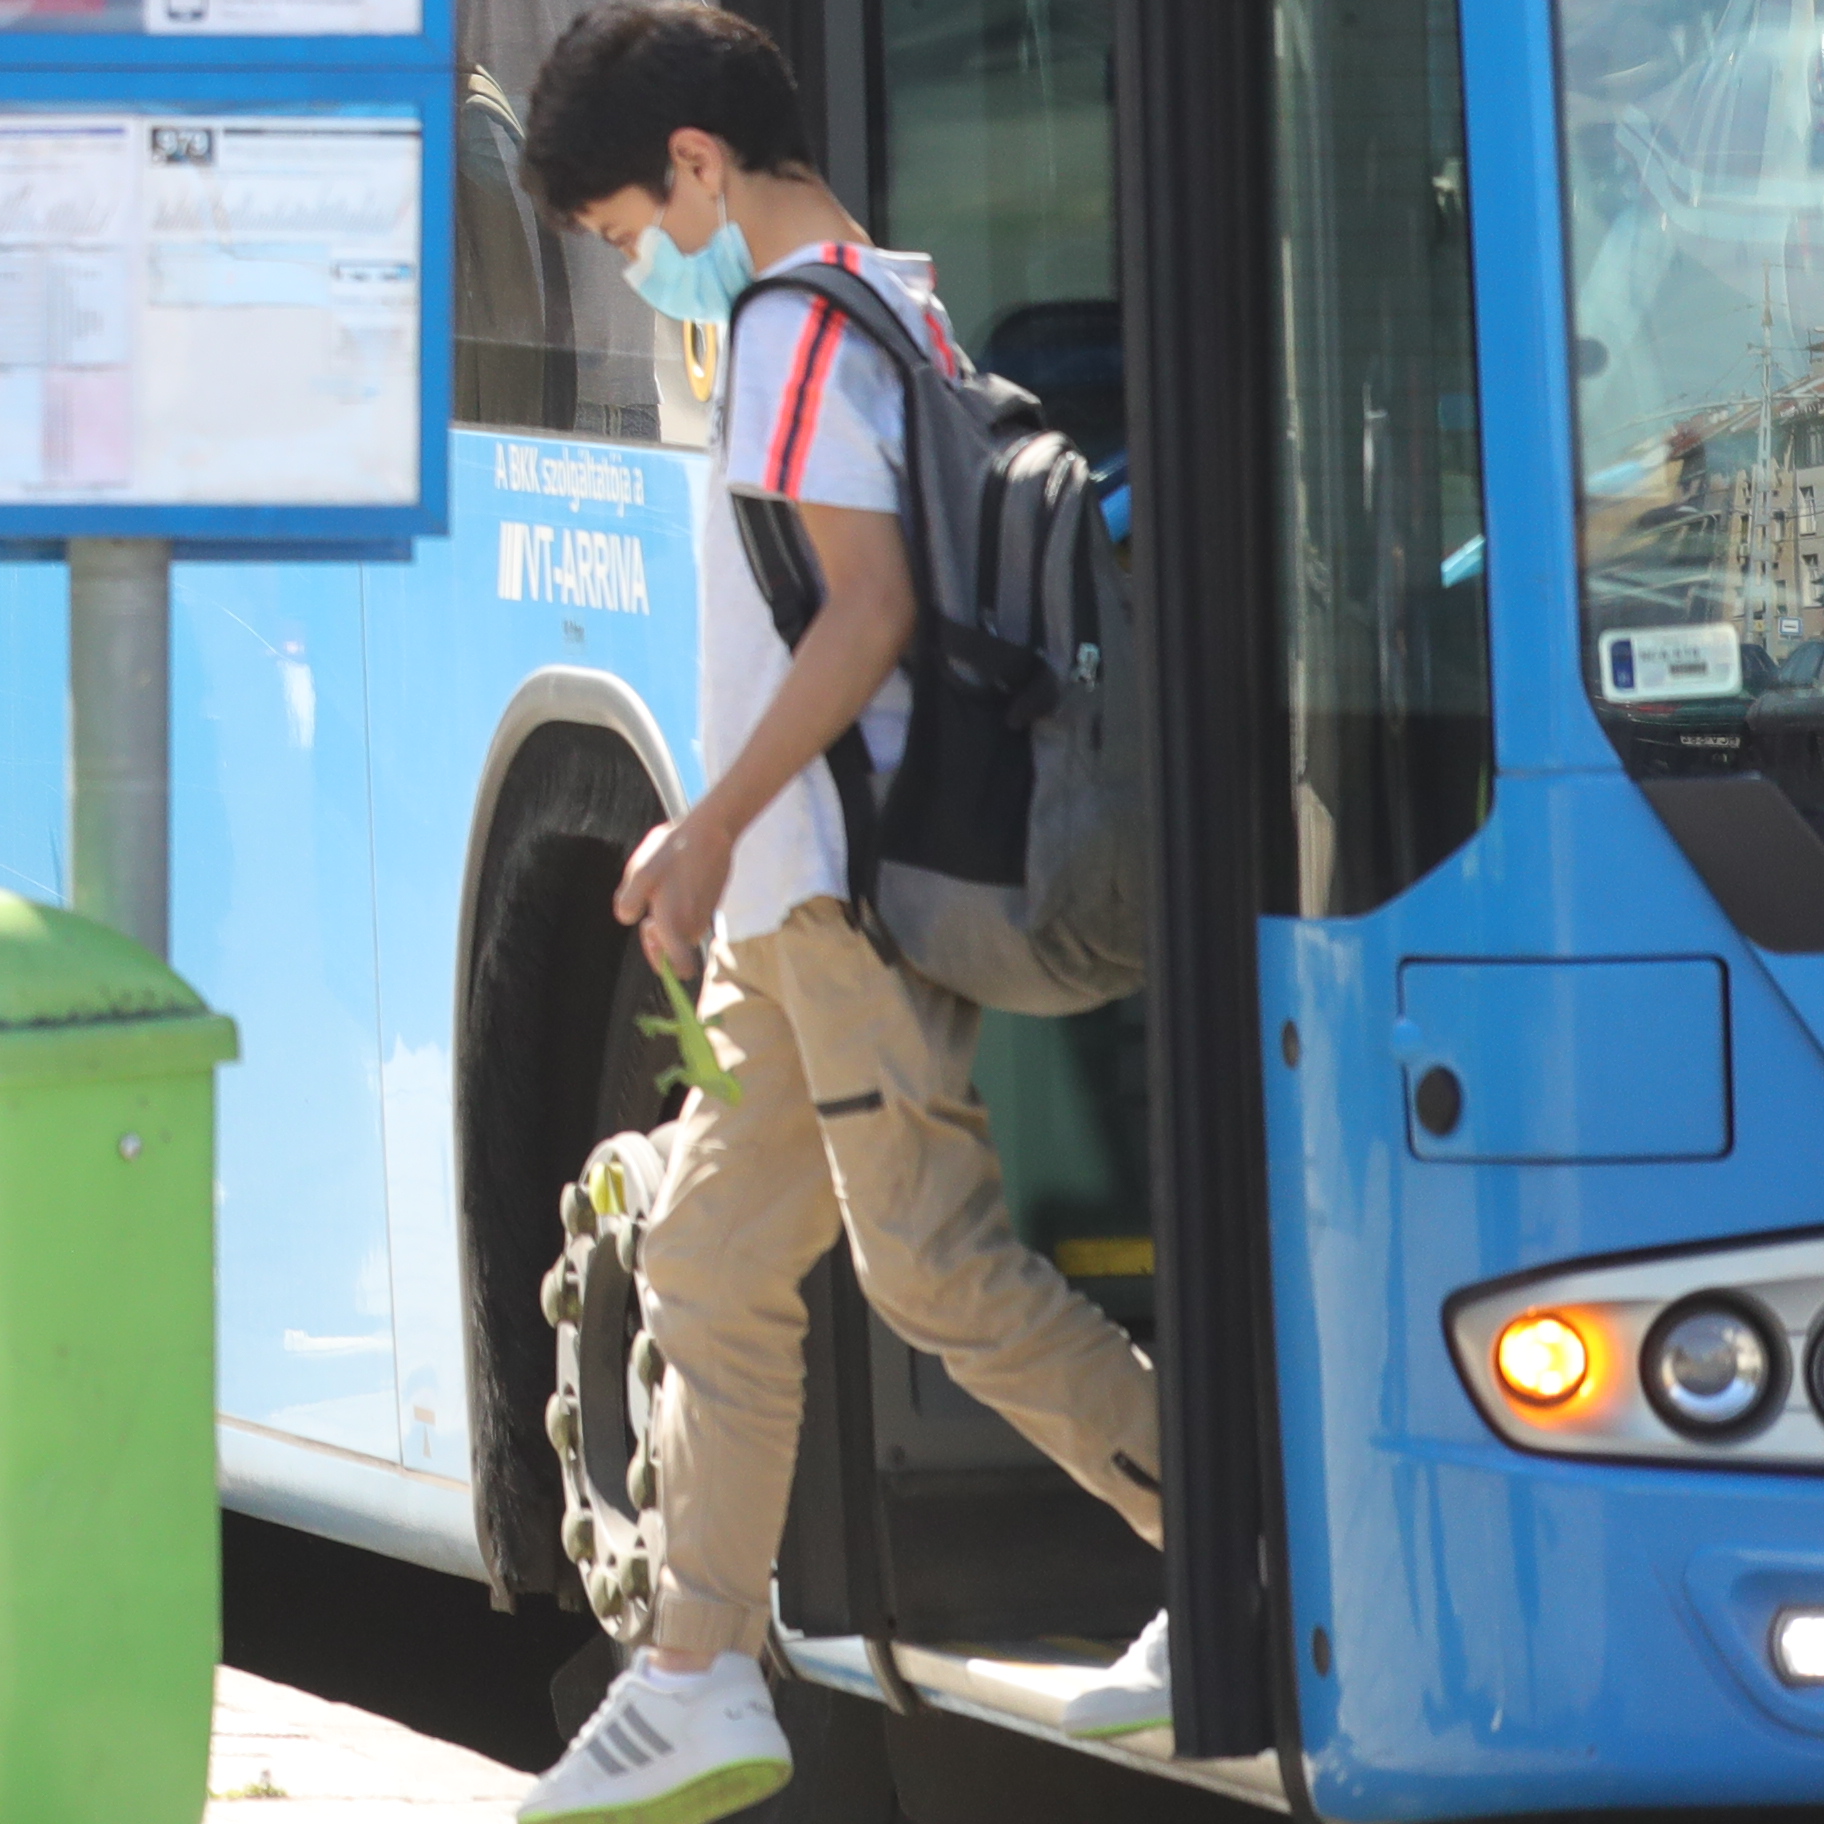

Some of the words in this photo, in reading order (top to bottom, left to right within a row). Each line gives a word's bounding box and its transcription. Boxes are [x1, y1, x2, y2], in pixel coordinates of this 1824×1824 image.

[495, 442, 508, 490] A
[510, 443, 540, 493] BKK
[633, 467, 645, 505] a
